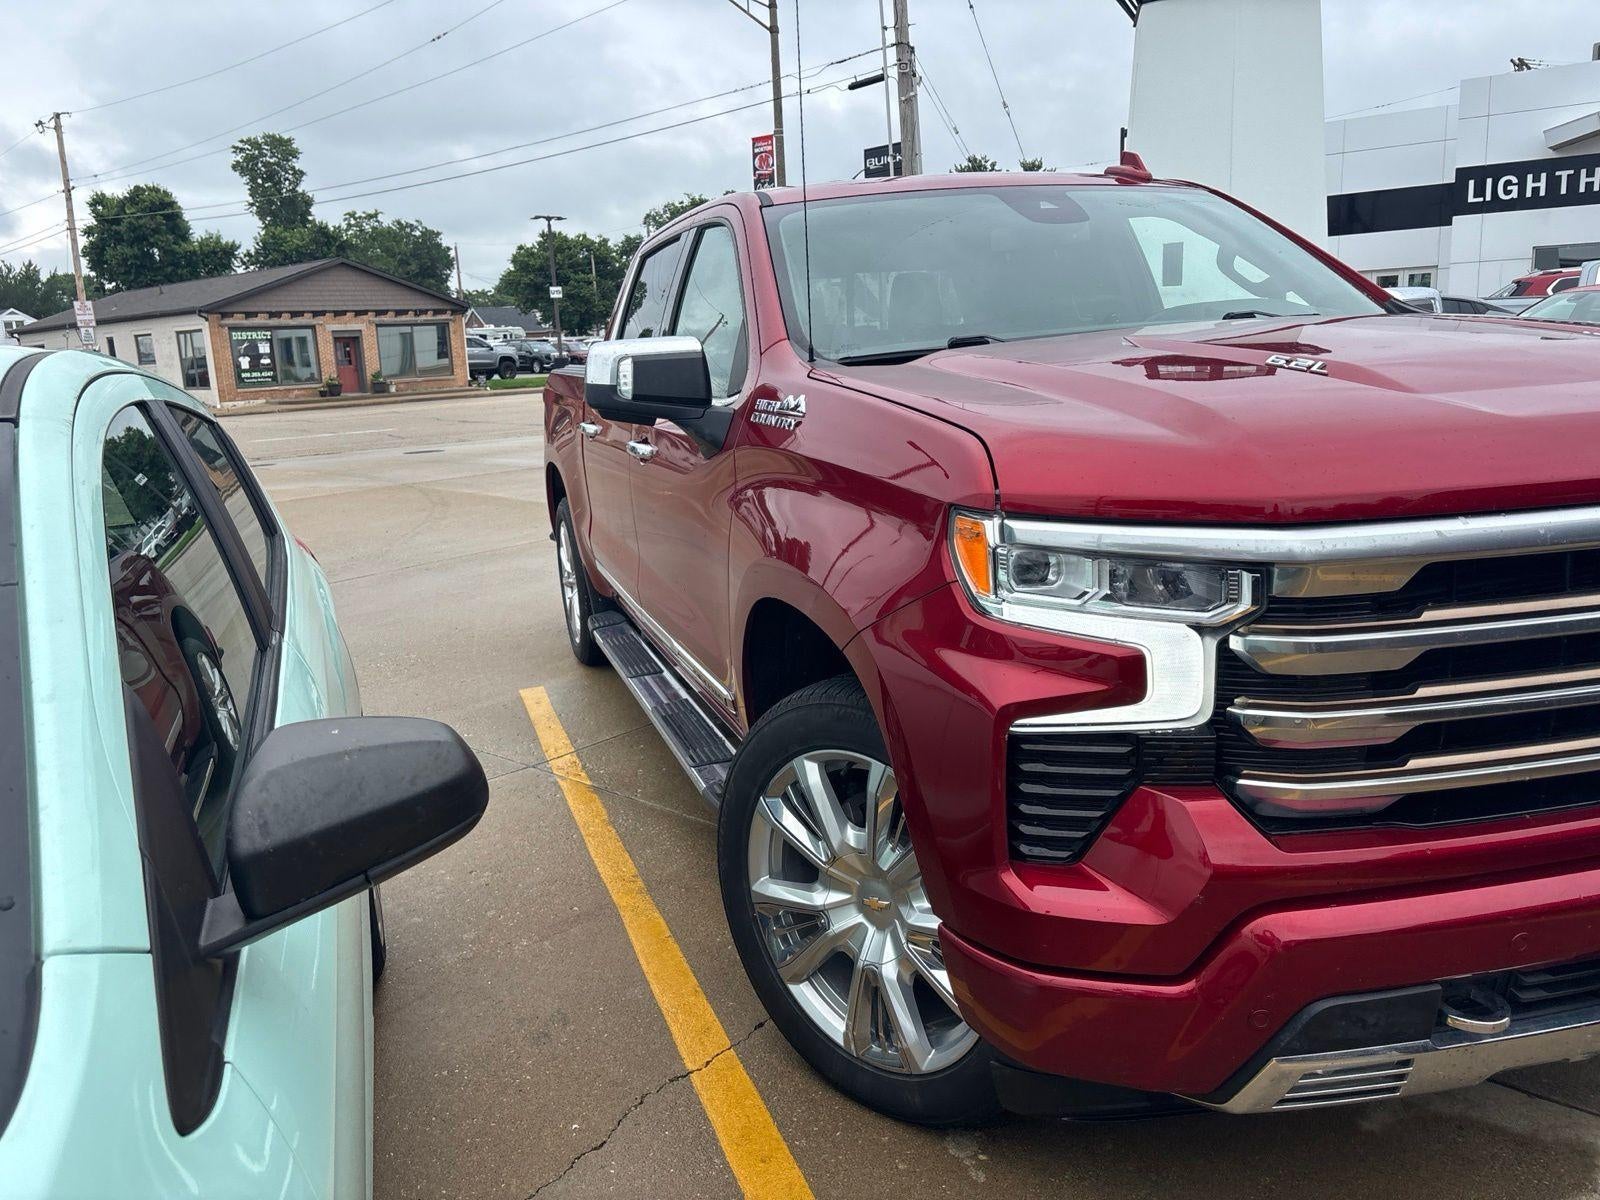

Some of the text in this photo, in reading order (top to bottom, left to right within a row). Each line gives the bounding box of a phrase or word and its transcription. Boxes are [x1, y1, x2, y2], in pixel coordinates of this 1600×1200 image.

[1467, 166, 1600, 203] LIGHTH
[232, 331, 272, 340] DISTRICT
[1265, 354, 1329, 376] 6.2L
[755, 399, 782, 412] HIGH
[750, 412, 797, 430] COUNTRY
